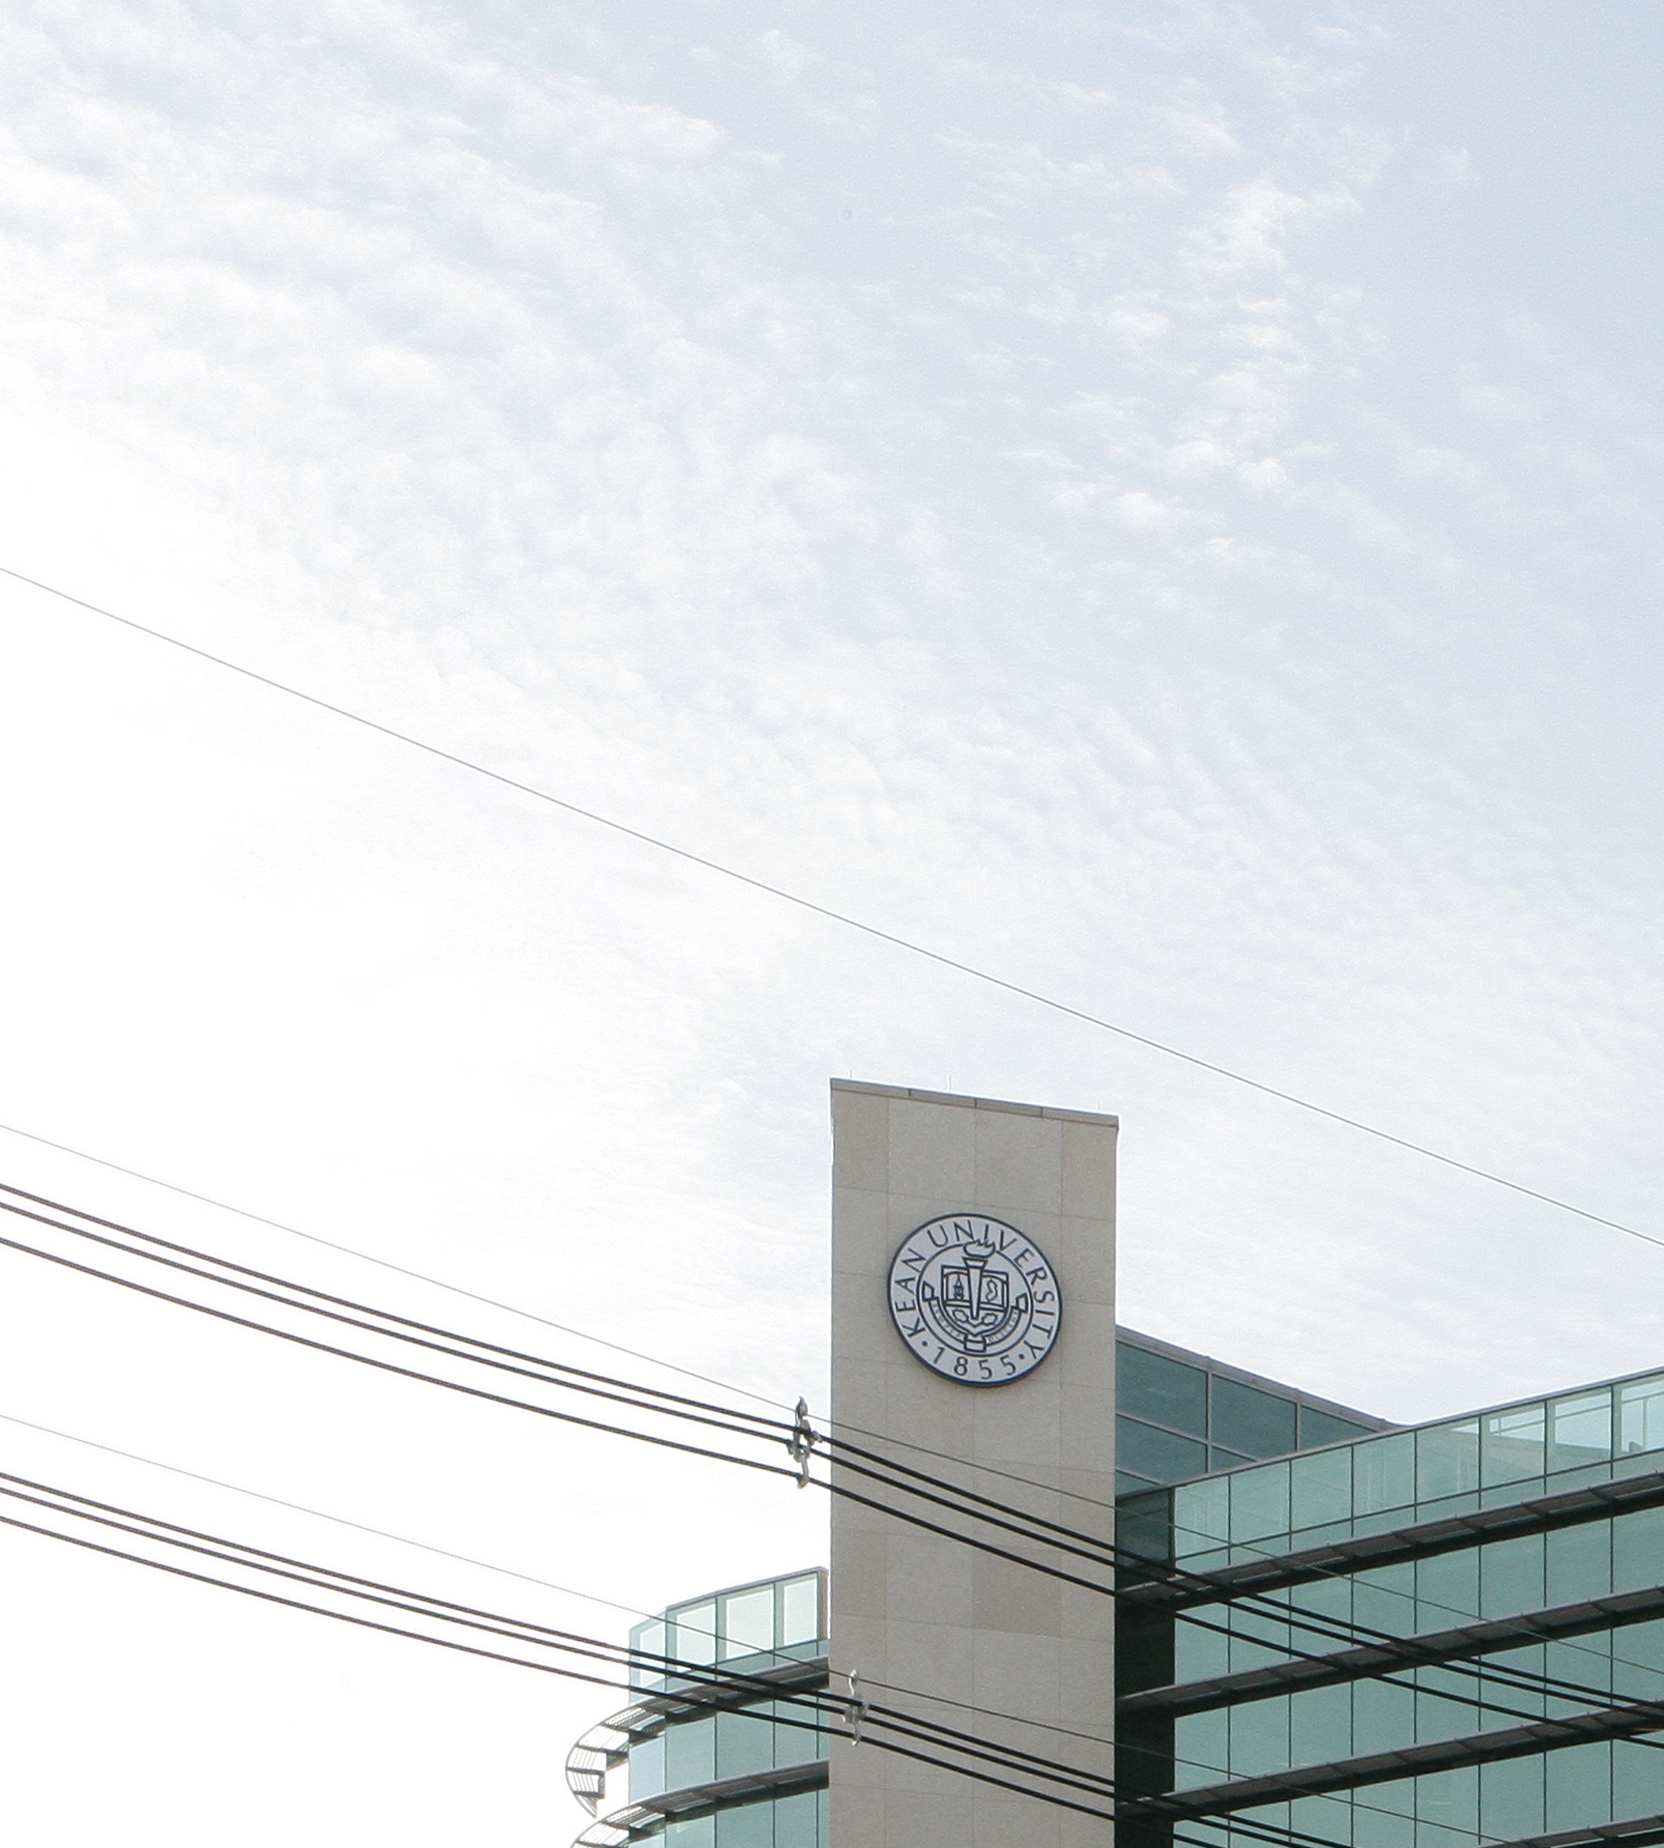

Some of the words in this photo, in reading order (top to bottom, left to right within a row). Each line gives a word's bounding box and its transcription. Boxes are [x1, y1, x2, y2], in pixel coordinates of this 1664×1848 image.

[895, 1247, 927, 1337] KEAN
[927, 1219, 1055, 1360] UNIVERSITY
[932, 1346, 1016, 1380] 1855
